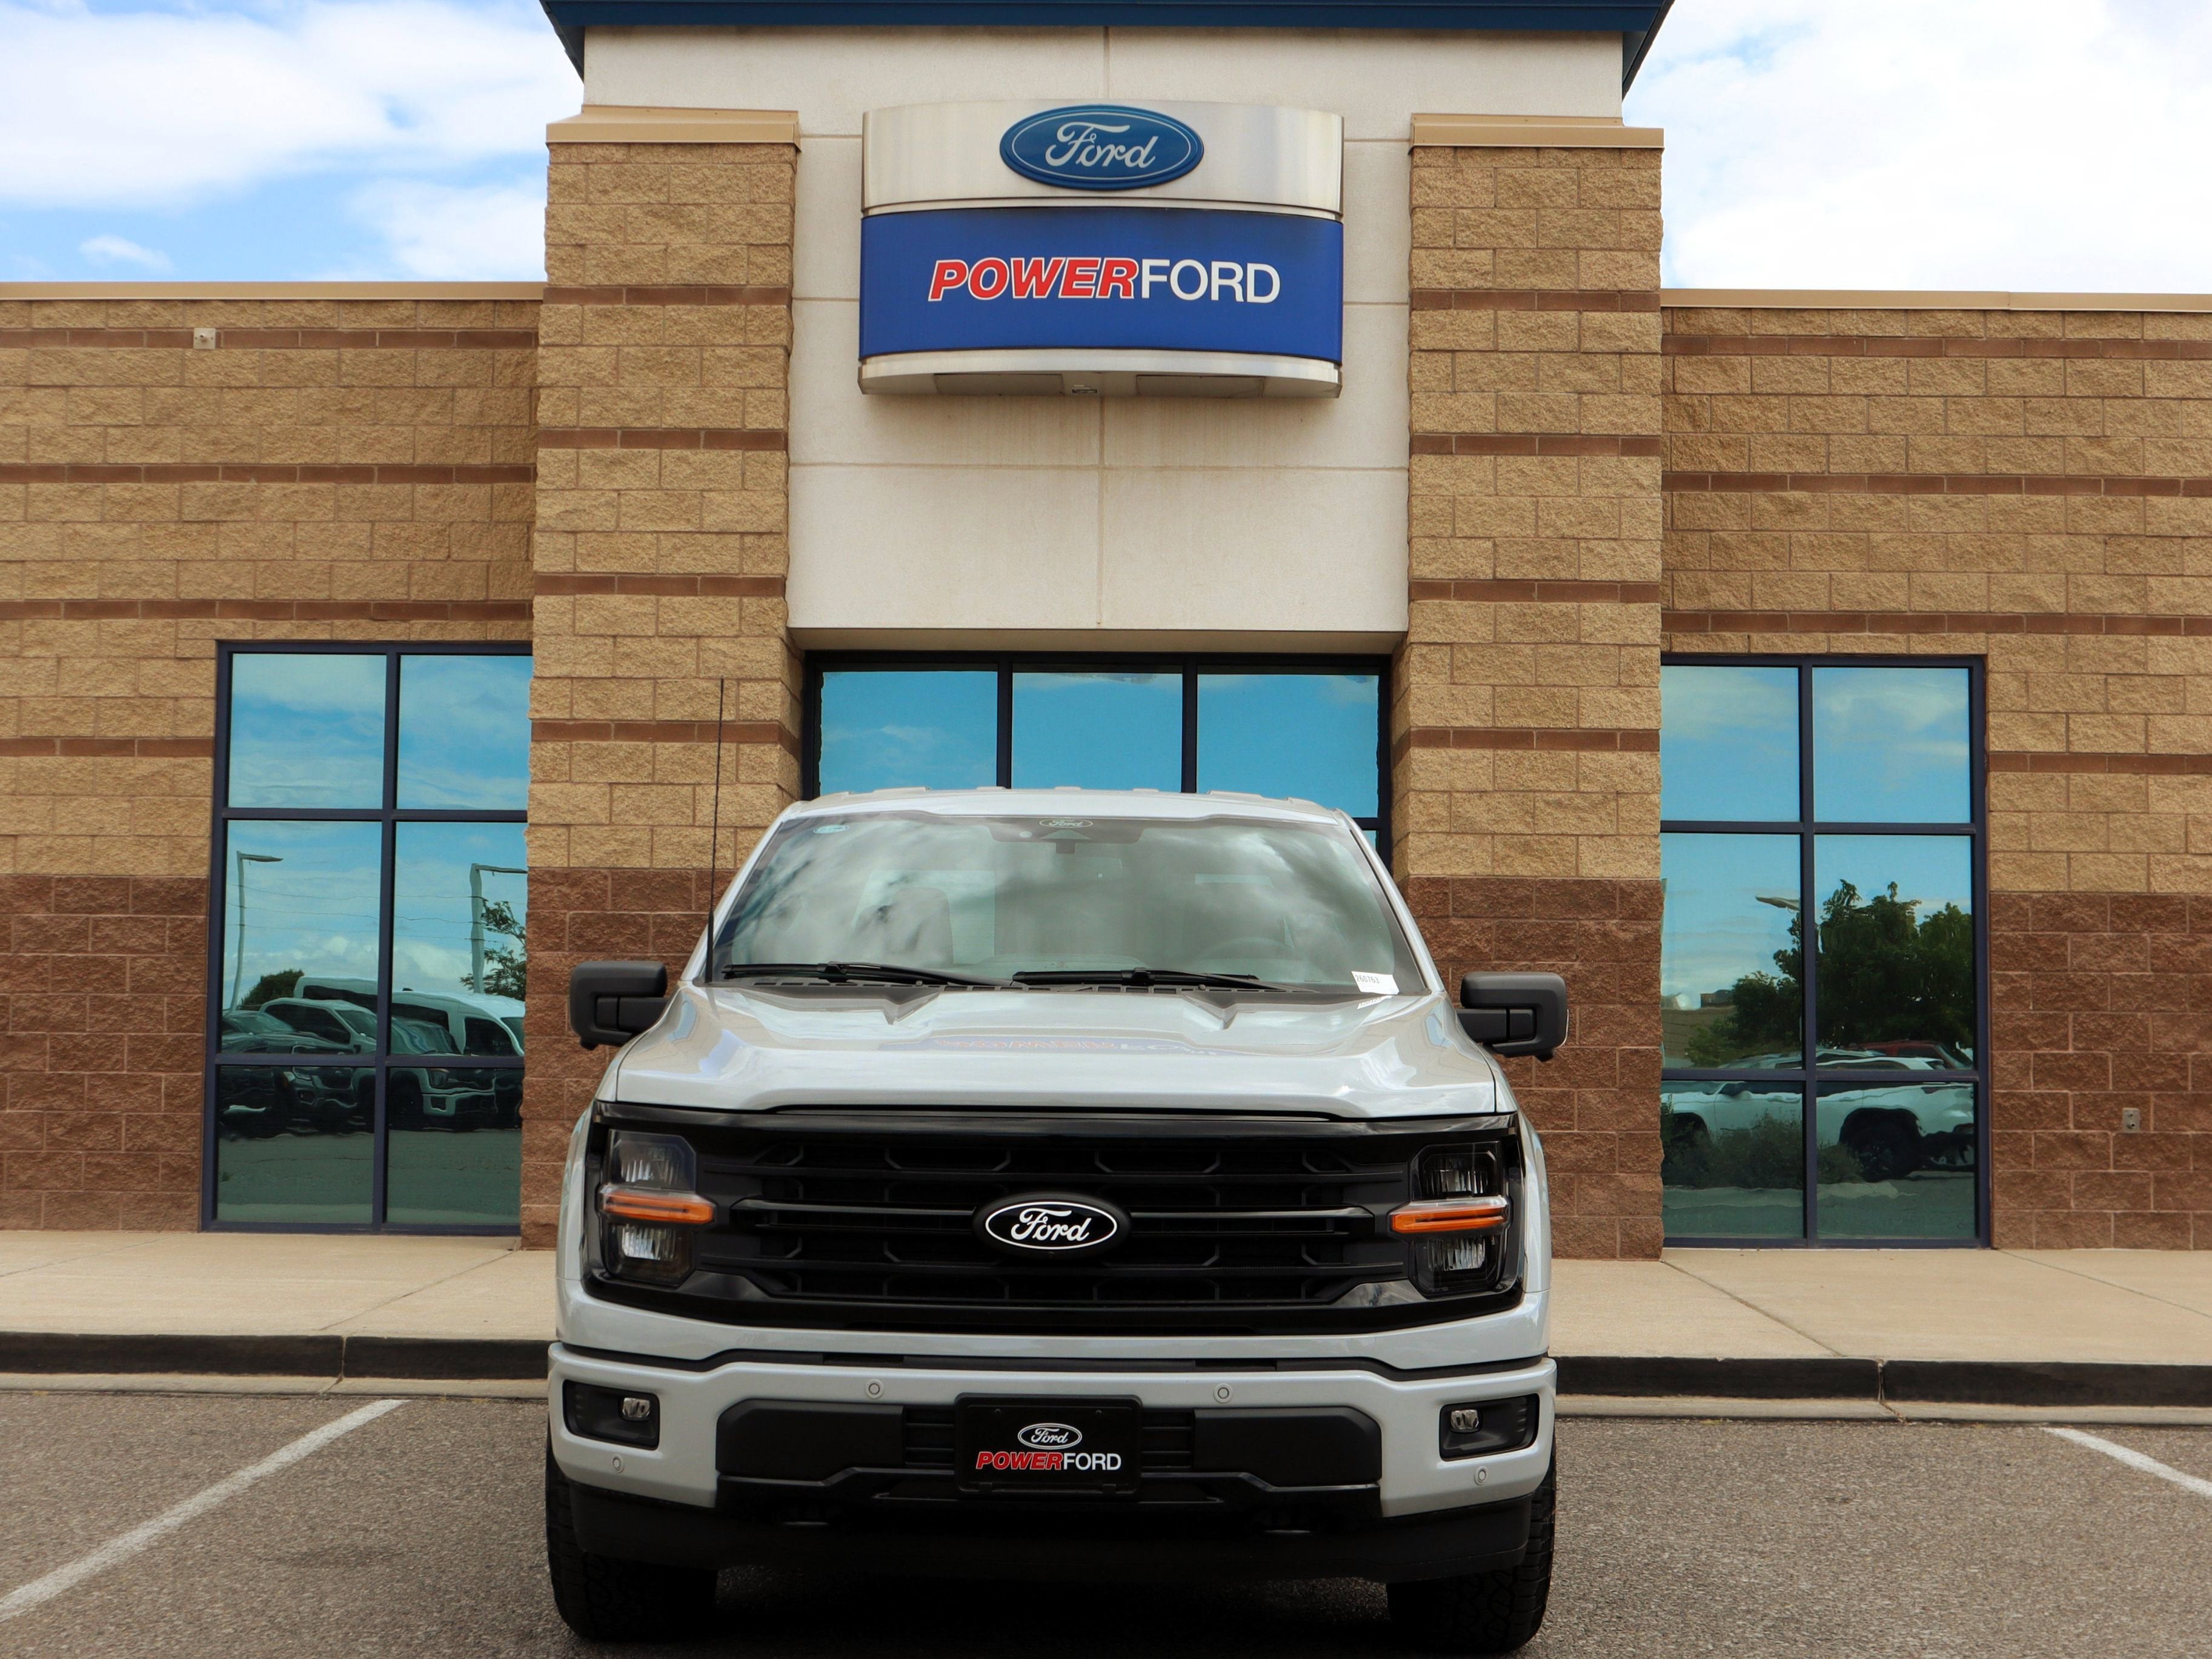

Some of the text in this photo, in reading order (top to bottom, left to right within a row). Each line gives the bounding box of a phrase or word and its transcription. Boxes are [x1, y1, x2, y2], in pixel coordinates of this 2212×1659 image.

[1045, 121, 1158, 169] Ford
[928, 257, 1281, 304] POWERFORD
[1011, 1208, 1092, 1242] Ford
[1031, 1428, 1069, 1444] Ford
[976, 1451, 1121, 1471] POWERFORD
